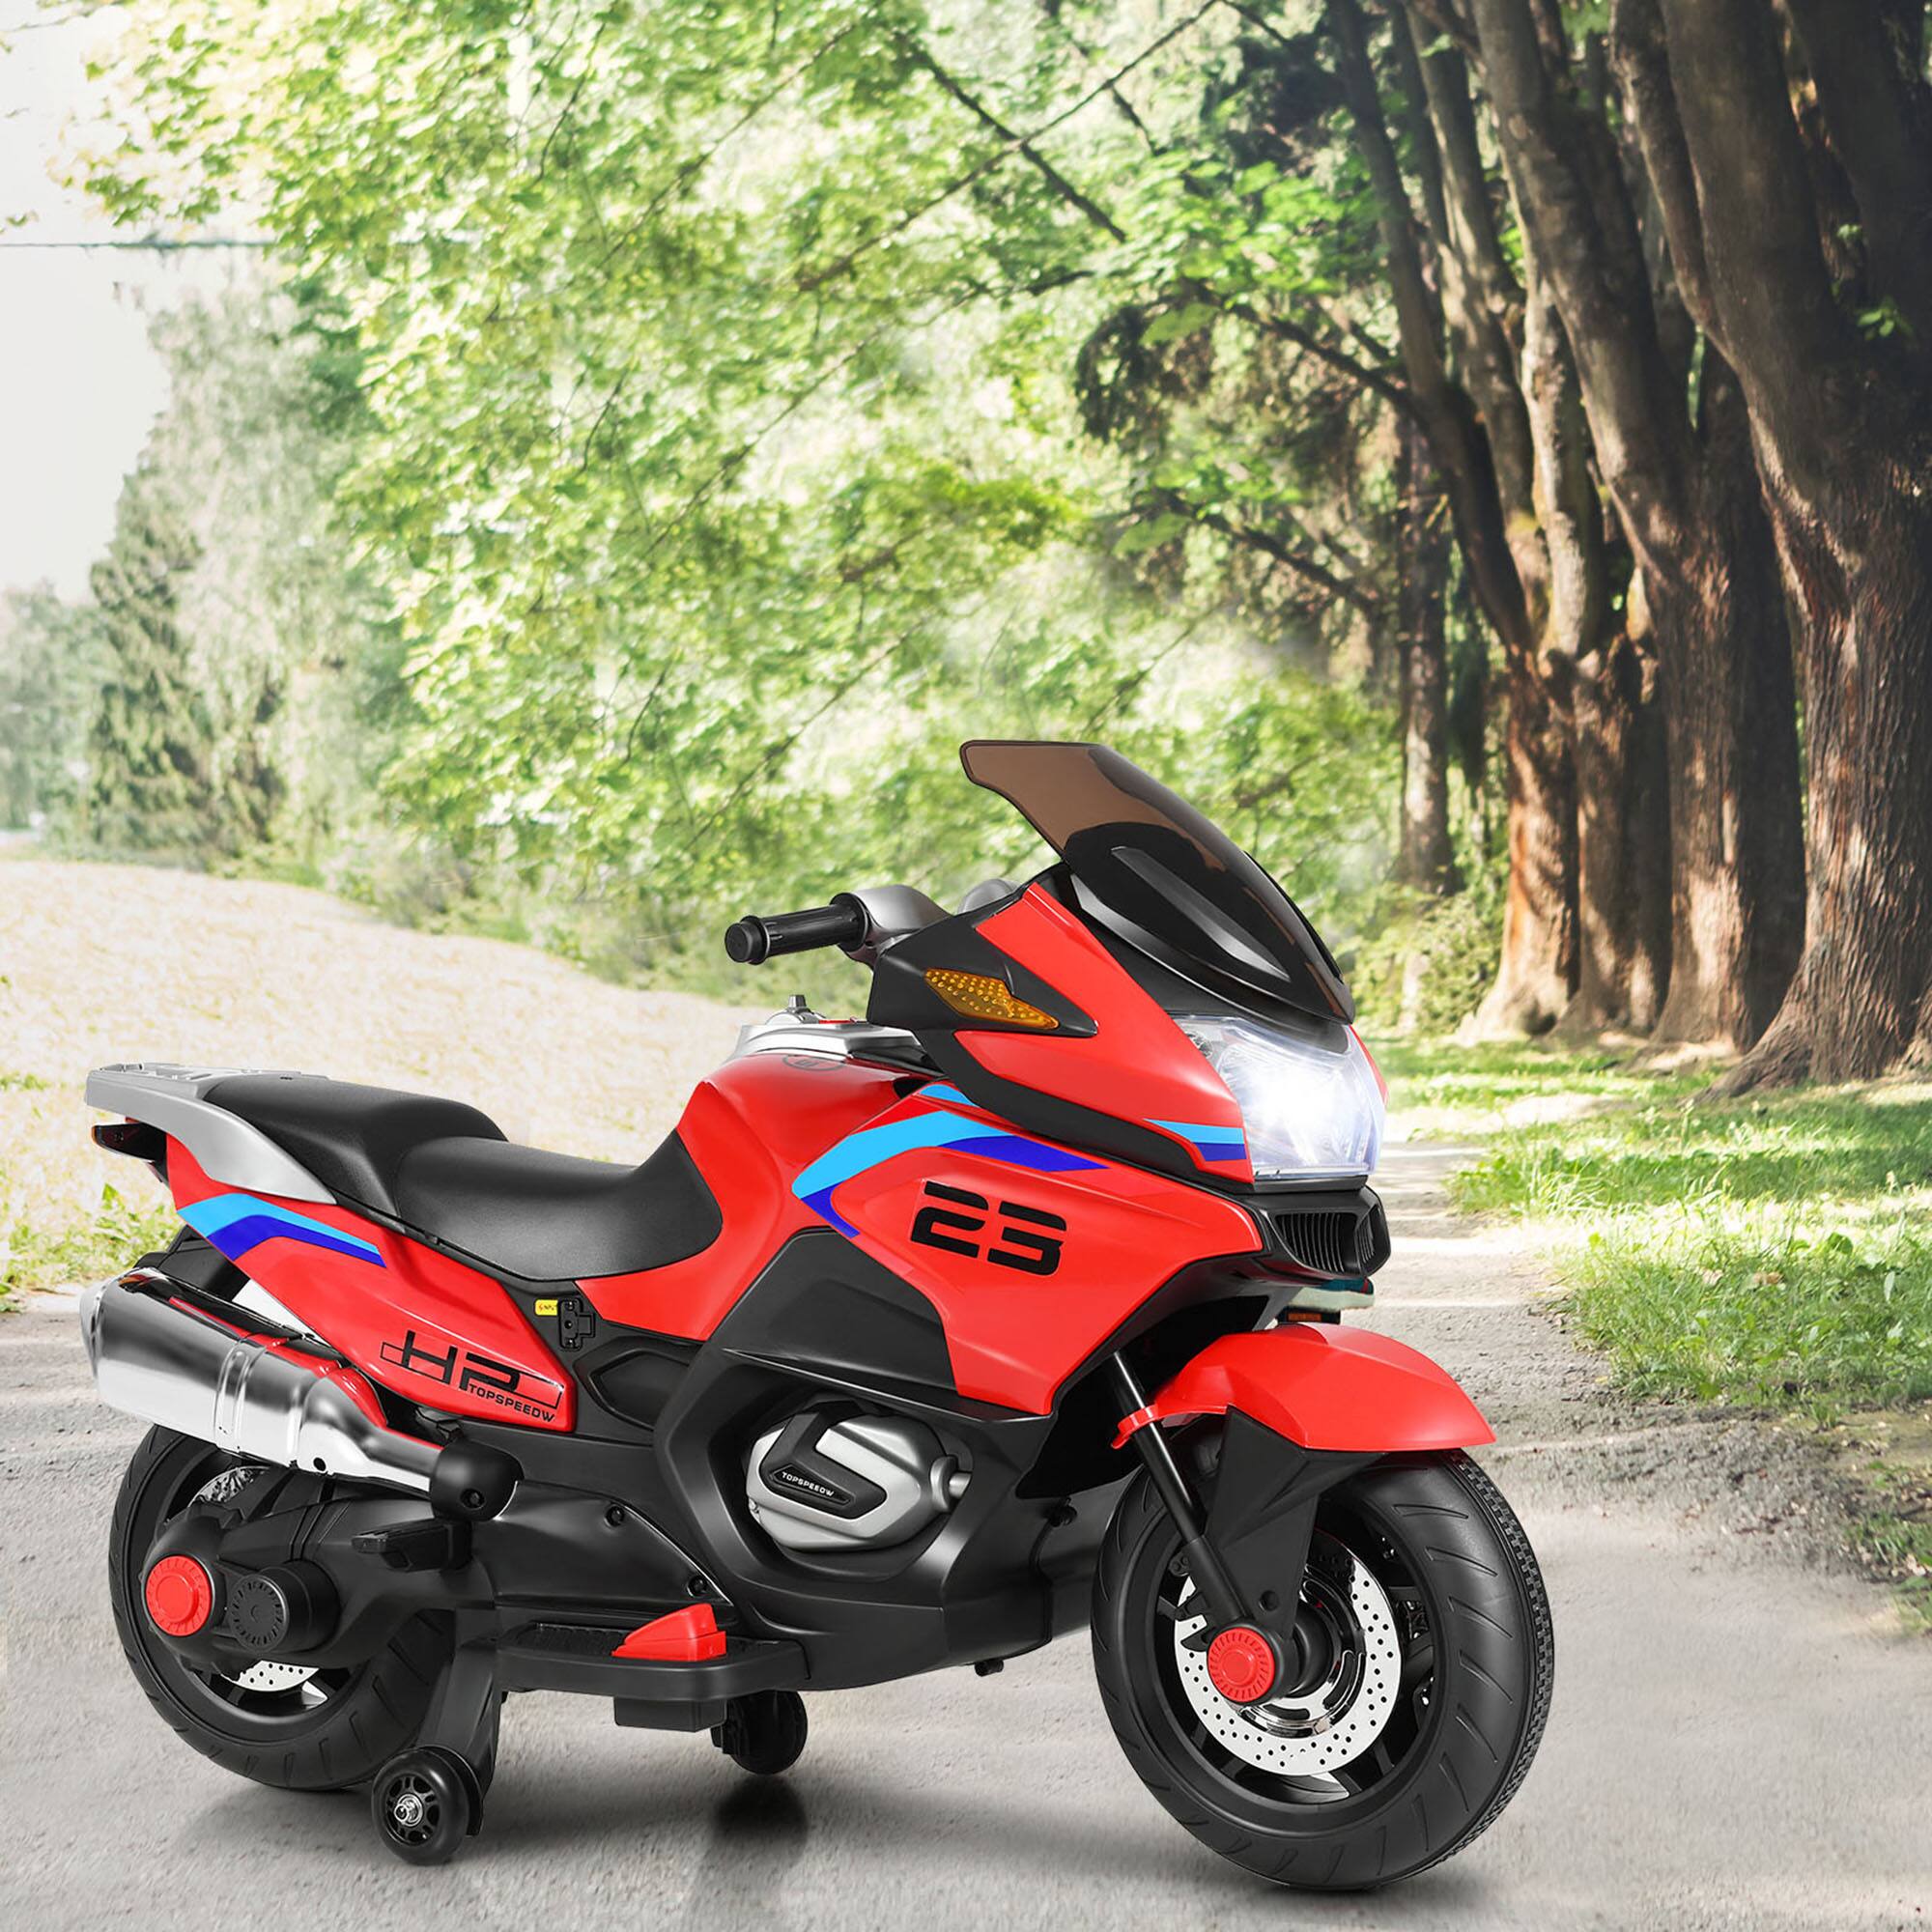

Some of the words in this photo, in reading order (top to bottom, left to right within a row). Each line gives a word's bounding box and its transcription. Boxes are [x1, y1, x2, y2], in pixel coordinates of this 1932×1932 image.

[911, 1180, 1067, 1276] 23
[402, 1330, 521, 1391] HP
[469, 1383, 554, 1422] TOPSPEEDW
